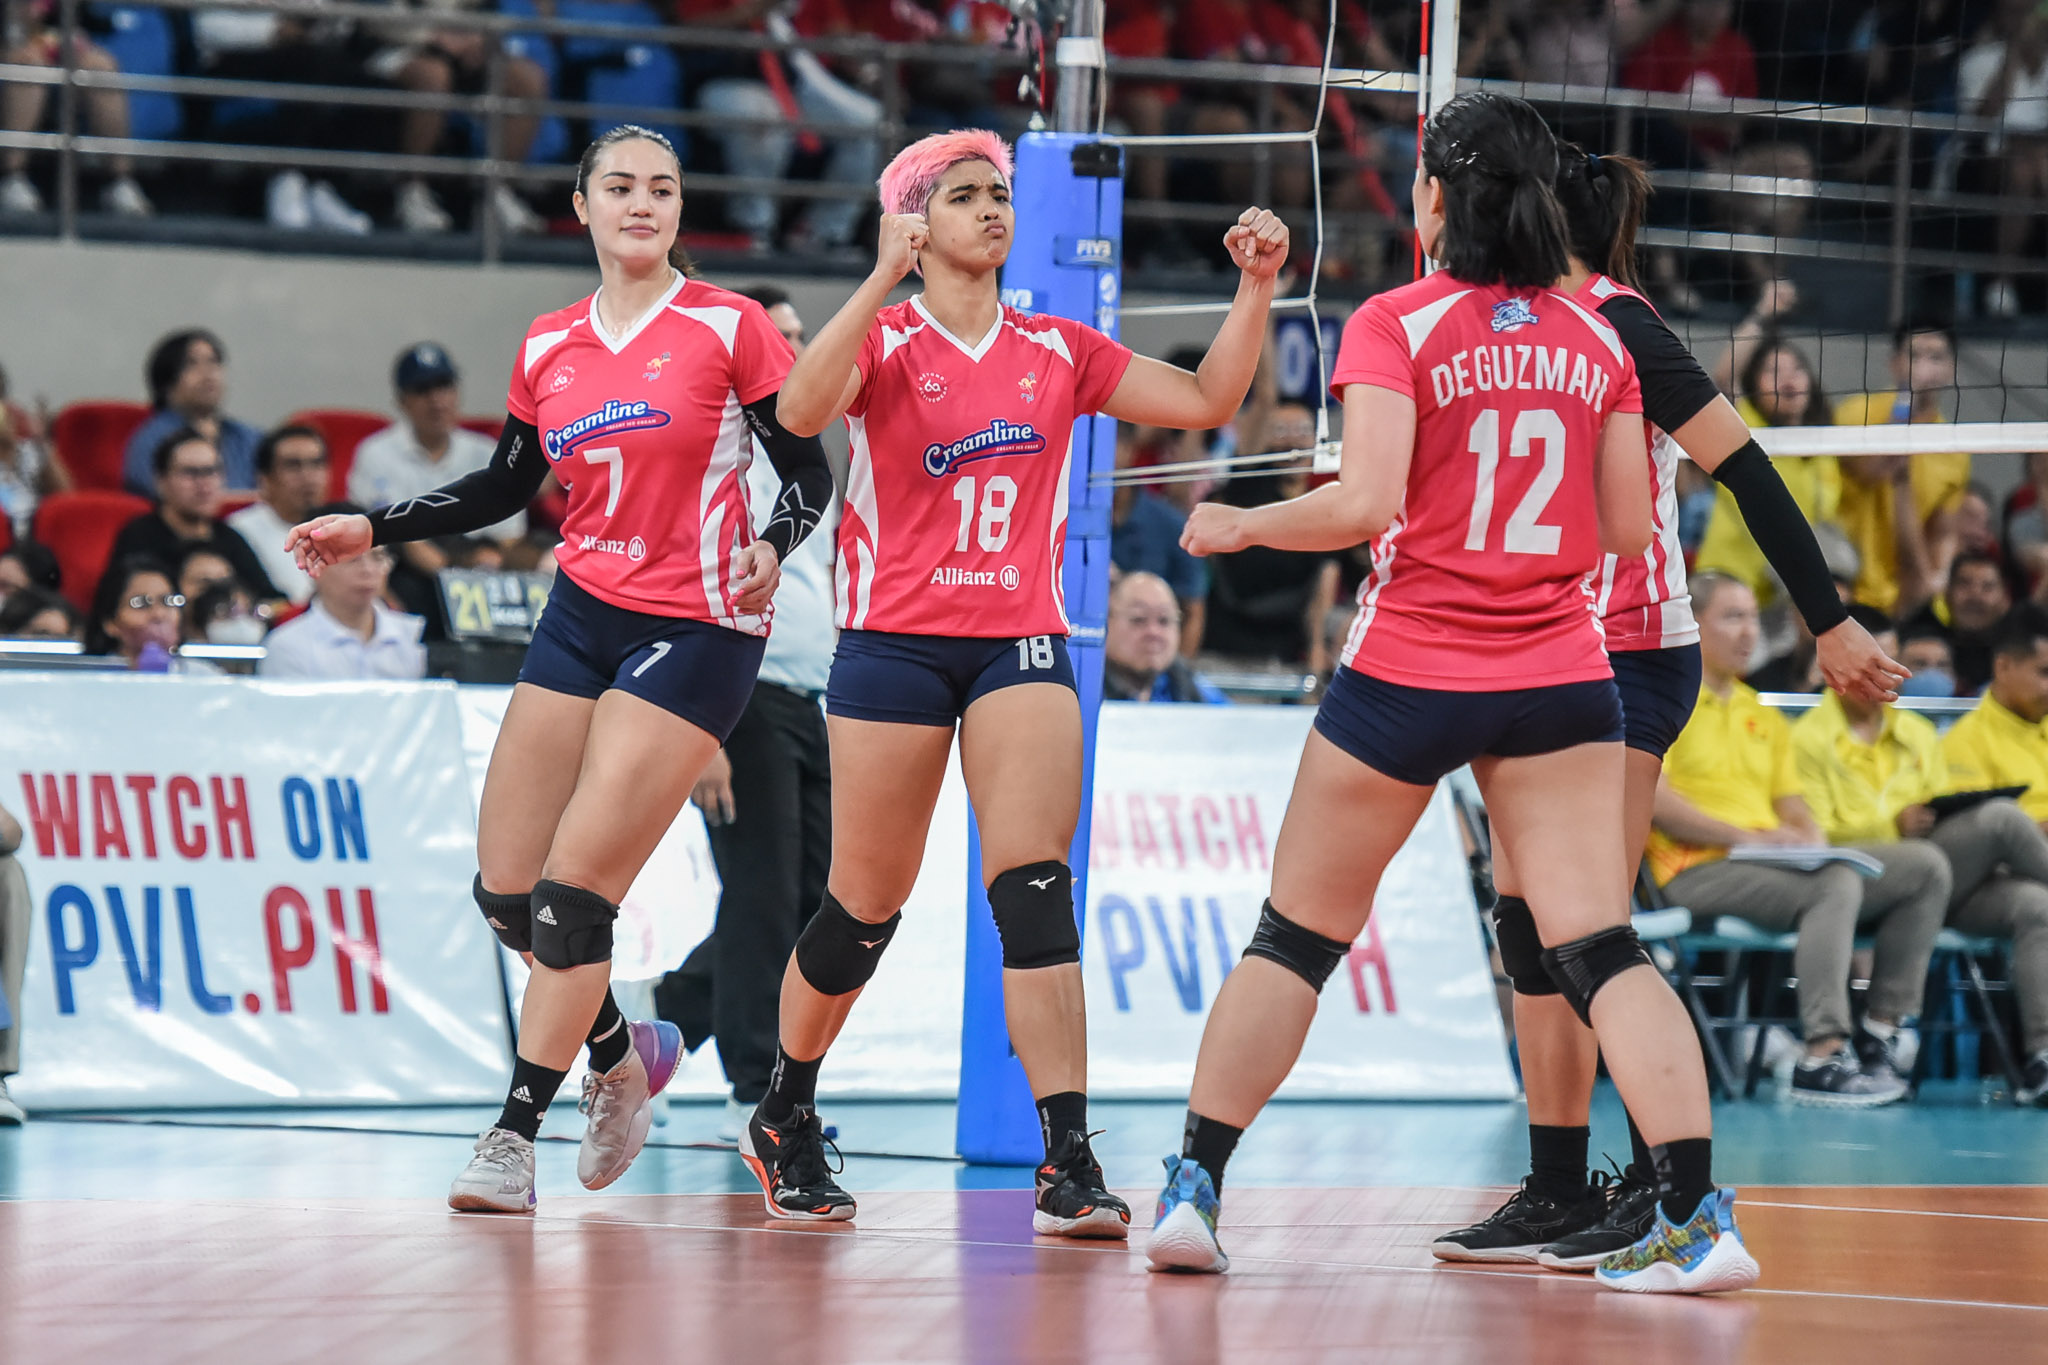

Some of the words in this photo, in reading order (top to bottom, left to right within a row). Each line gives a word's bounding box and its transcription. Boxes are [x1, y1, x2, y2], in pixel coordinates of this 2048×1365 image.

[545, 400, 647, 461] Creamline
[925, 420, 1032, 476] Creamline
[583, 446, 624, 517] 7
[1464, 408, 1566, 555] 12
[953, 475, 1018, 553] 18
[449, 579, 492, 632] 21
[930, 567, 996, 586] Allianz
[631, 641, 673, 678] 7
[1015, 635, 1055, 670] 18
[20, 773, 258, 860] WATCH
[281, 777, 370, 861] ON
[46, 885, 390, 1015] PVL.PH
